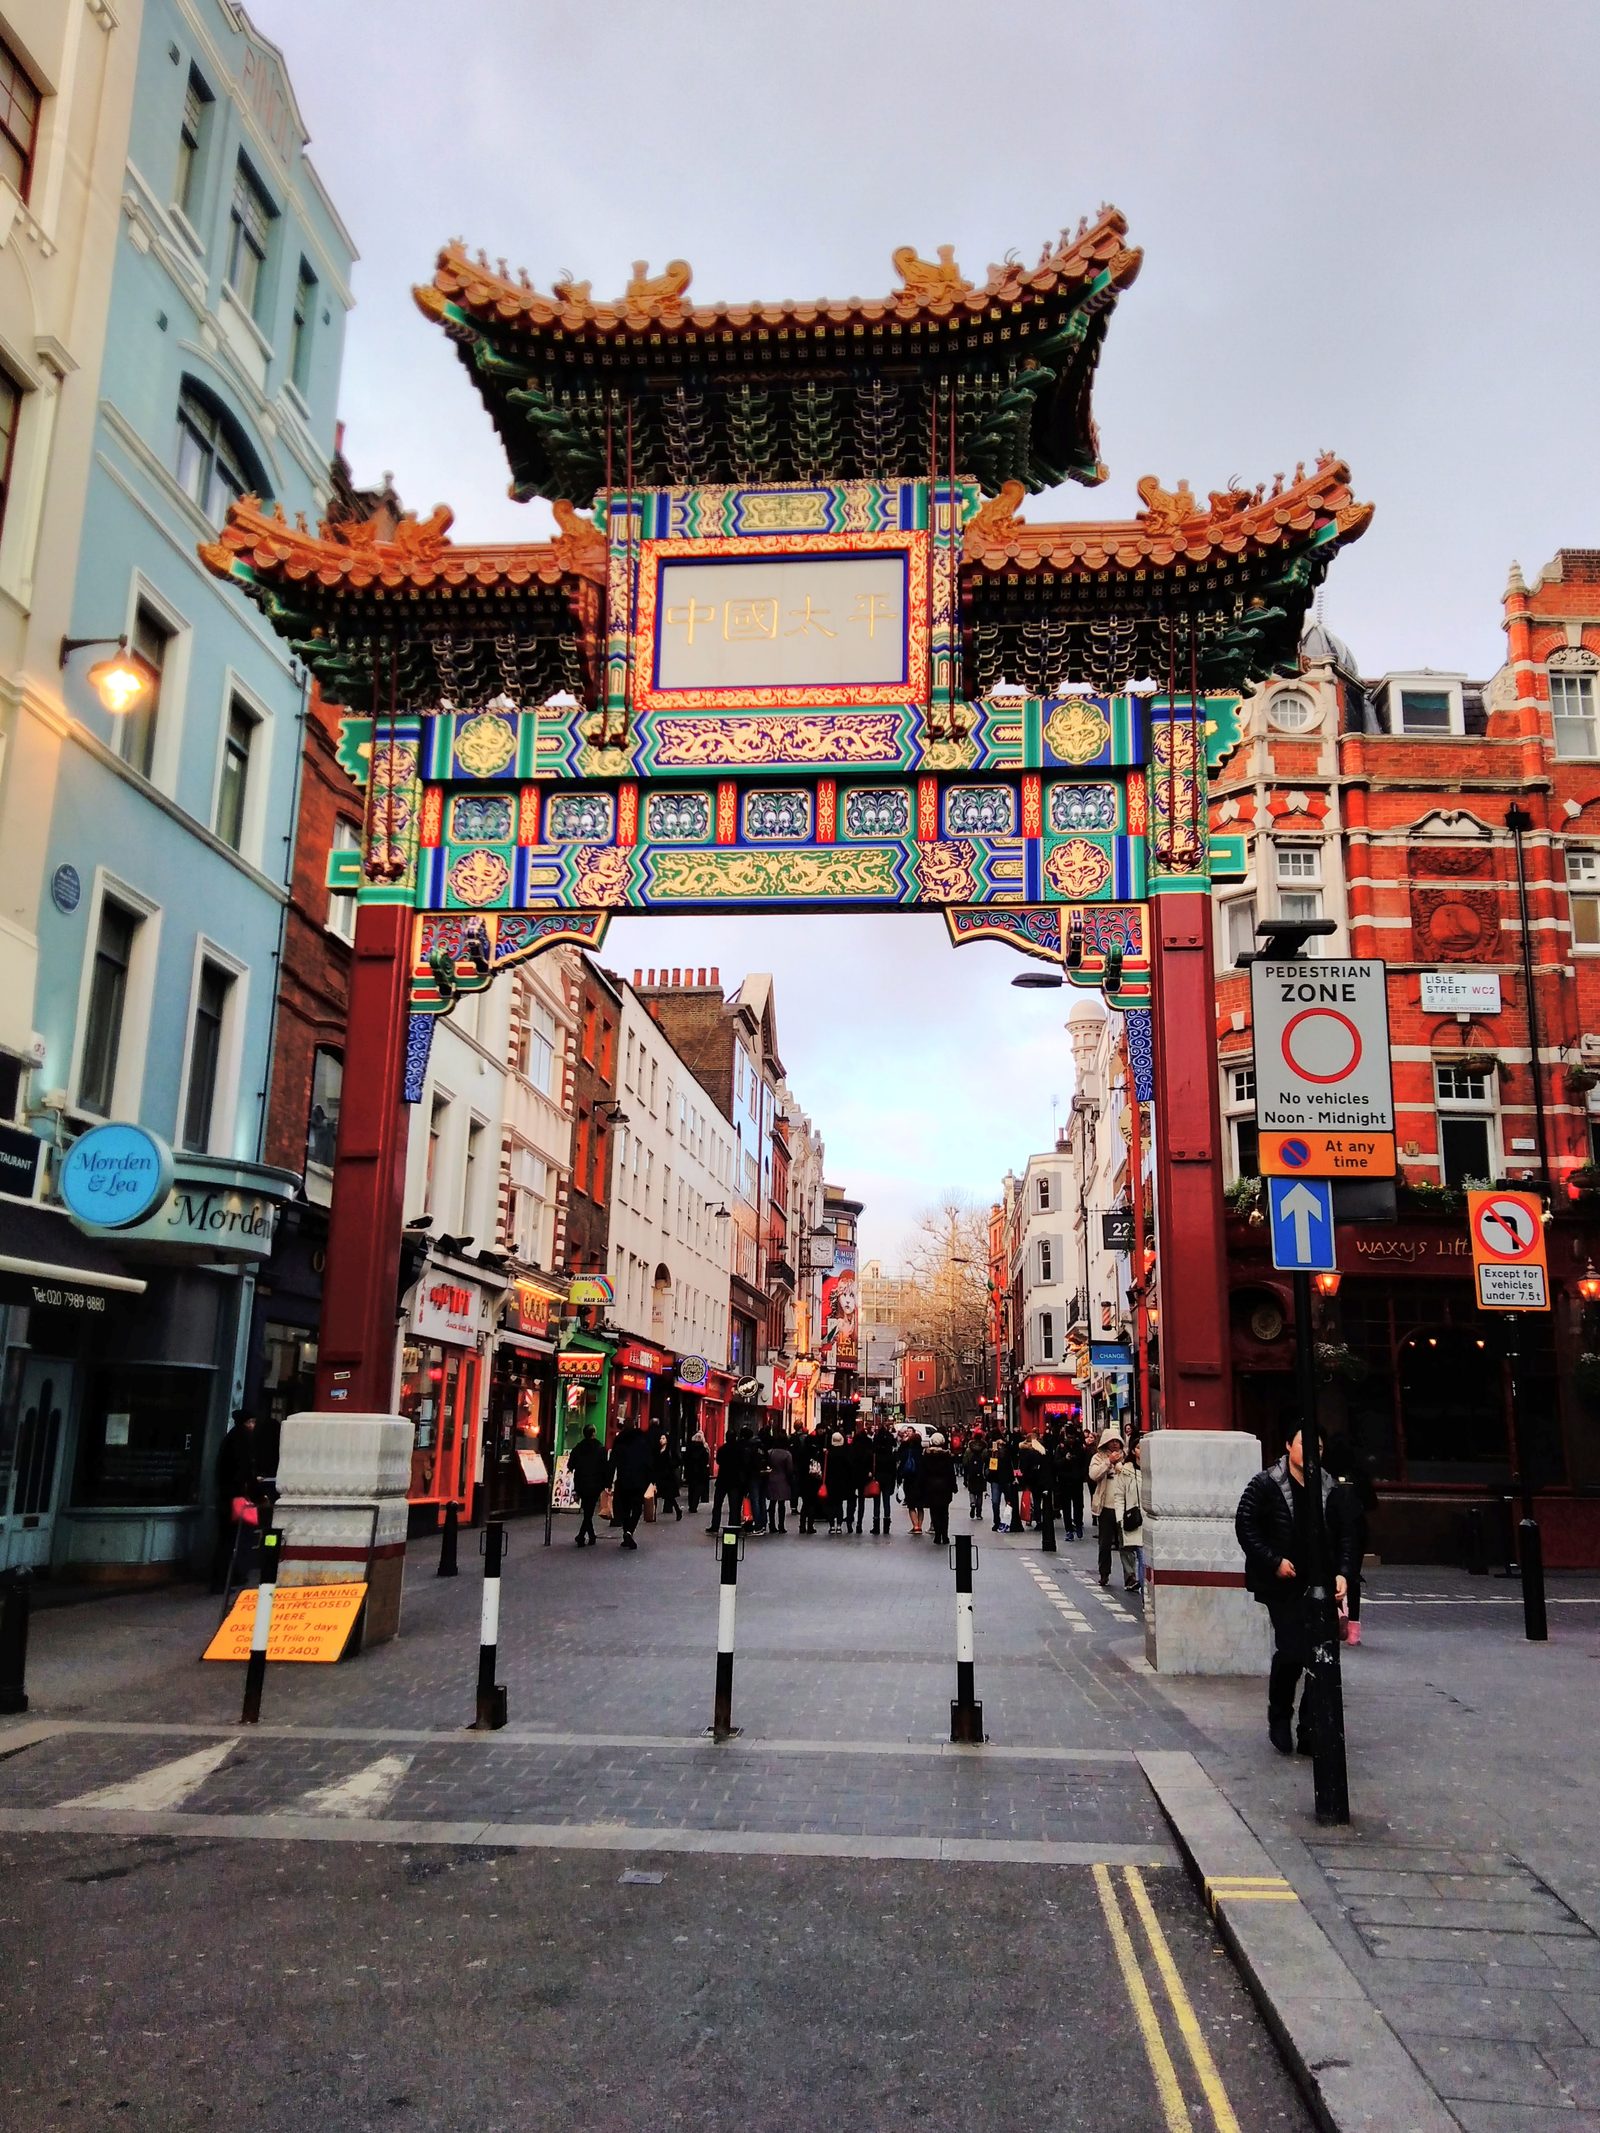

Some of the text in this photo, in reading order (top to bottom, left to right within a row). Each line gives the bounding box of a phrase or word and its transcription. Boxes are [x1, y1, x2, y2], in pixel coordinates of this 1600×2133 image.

[666, 593, 897, 646] 中國太平
[1265, 966, 1371, 978] PEDESTRIAN
[1425, 976, 1454, 984] LISLE
[1281, 983, 1357, 1002] ZONE
[1426, 986, 1496, 995] STREET WC2
[1280, 1092, 1370, 1105] No vehicles
[1264, 1111, 1305, 1124] Noon
[1318, 1112, 1387, 1127] Midnight
[1325, 1140, 1376, 1156] At any
[73, 1150, 151, 1172] Morden
[1333, 1155, 1368, 1168] time
[87, 1173, 137, 1197] & Lea
[167, 1195, 271, 1240] Morden
[1112, 1222, 1130, 1236] 22
[1484, 1269, 1539, 1280] Except for
[1491, 1280, 1534, 1290] vehicles
[64, 1291, 85, 1309] 7989
[86, 1294, 105, 1312] 8880
[1486, 1291, 1516, 1301] under
[302, 1588, 359, 1598] WARNING
[304, 1600, 352, 1609] CLOSED
[274, 1612, 306, 1621] HERE
[283, 1623, 298, 1632] for
[304, 1622, 312, 1631] 7
[313, 1622, 339, 1632] days
[288, 1646, 320, 1656] 2403
